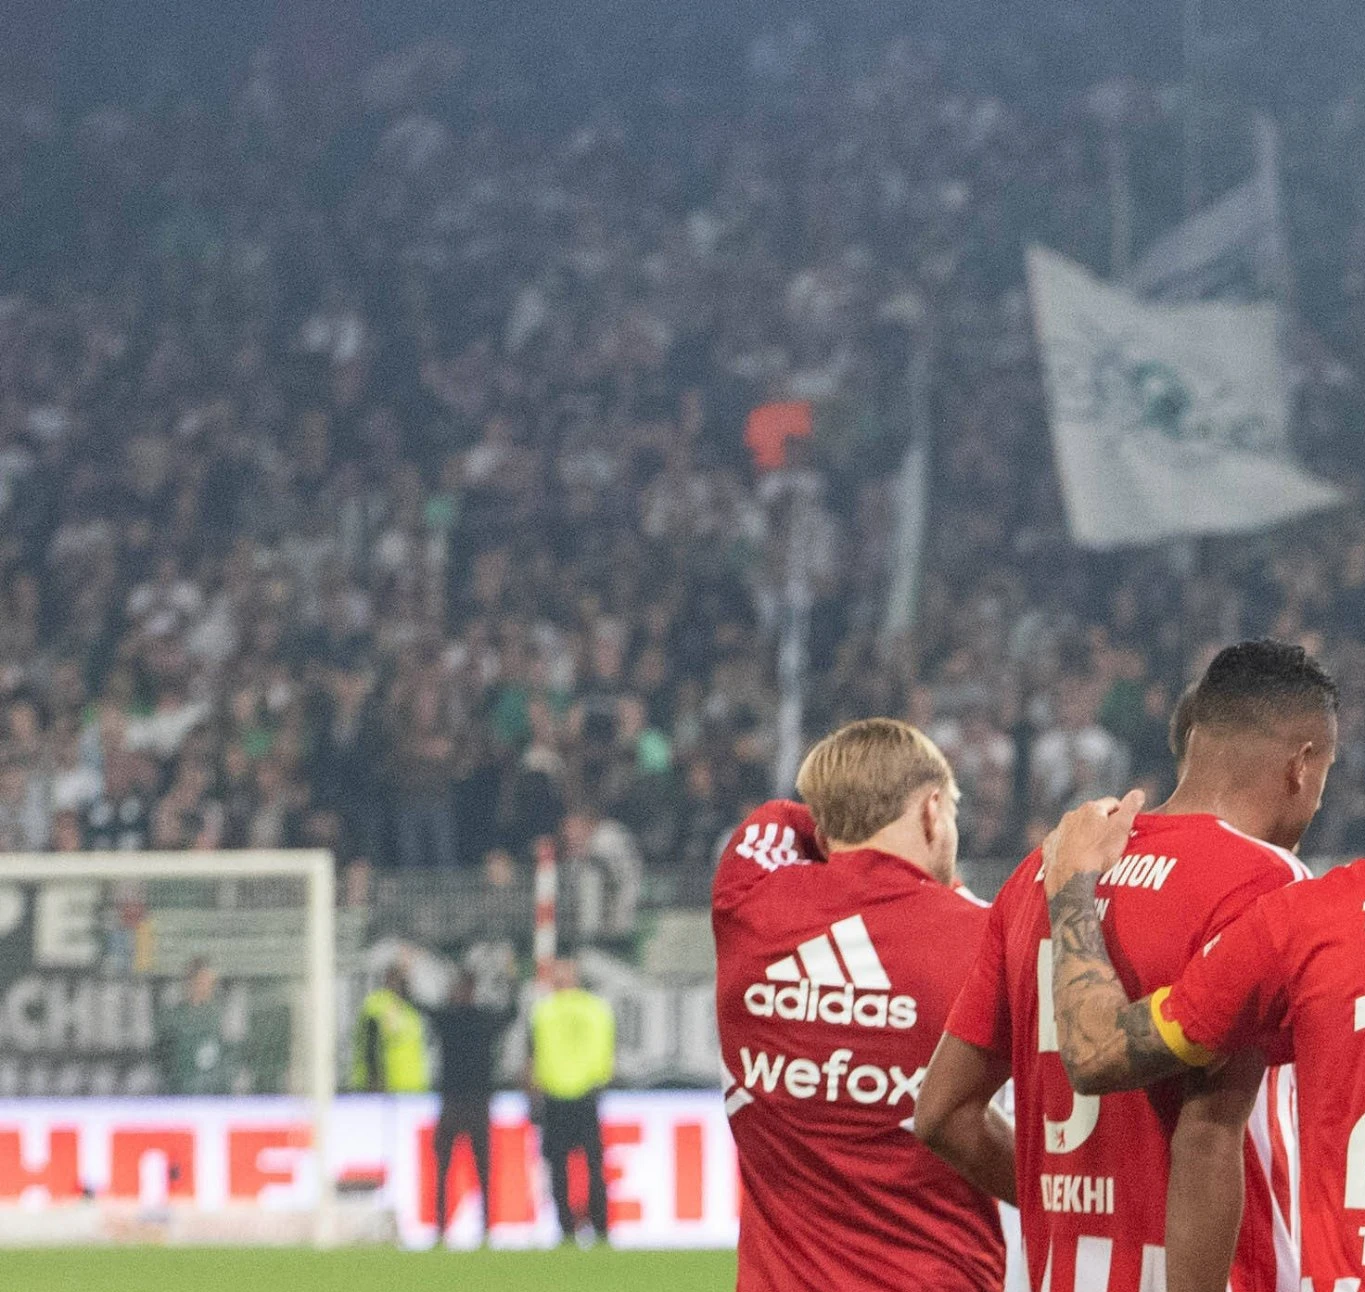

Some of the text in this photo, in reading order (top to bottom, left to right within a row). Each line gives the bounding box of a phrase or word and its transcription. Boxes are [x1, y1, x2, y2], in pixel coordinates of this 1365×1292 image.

[1098, 853, 1178, 891] NION
[744, 978, 917, 1029] adidas
[740, 1047, 928, 1106] wefox
